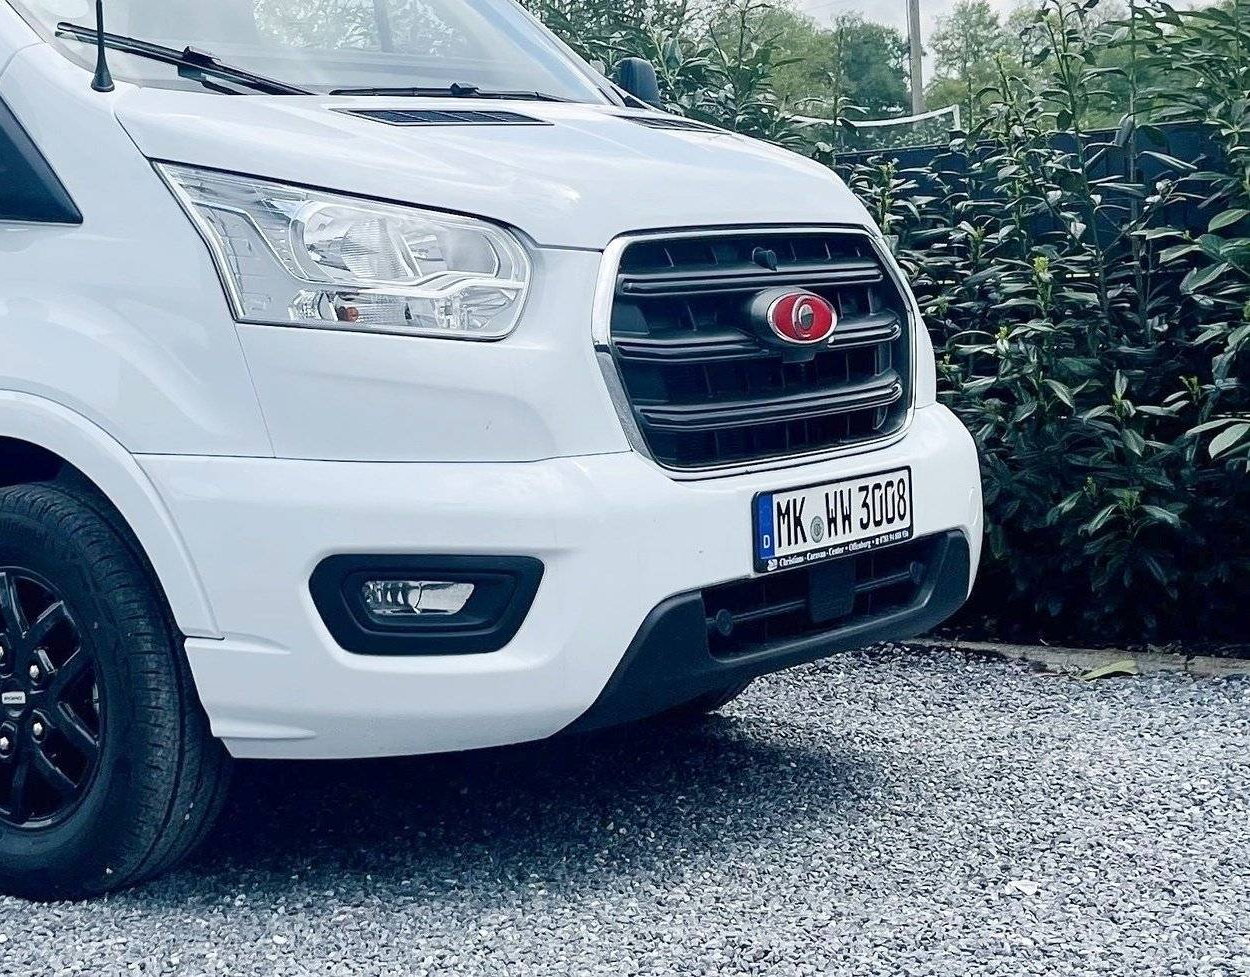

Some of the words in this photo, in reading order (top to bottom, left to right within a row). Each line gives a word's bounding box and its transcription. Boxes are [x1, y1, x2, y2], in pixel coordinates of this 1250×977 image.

[777, 497, 807, 548] MK
[825, 488, 852, 538] WW
[858, 478, 907, 530] 3008
[763, 535, 770, 549] D
